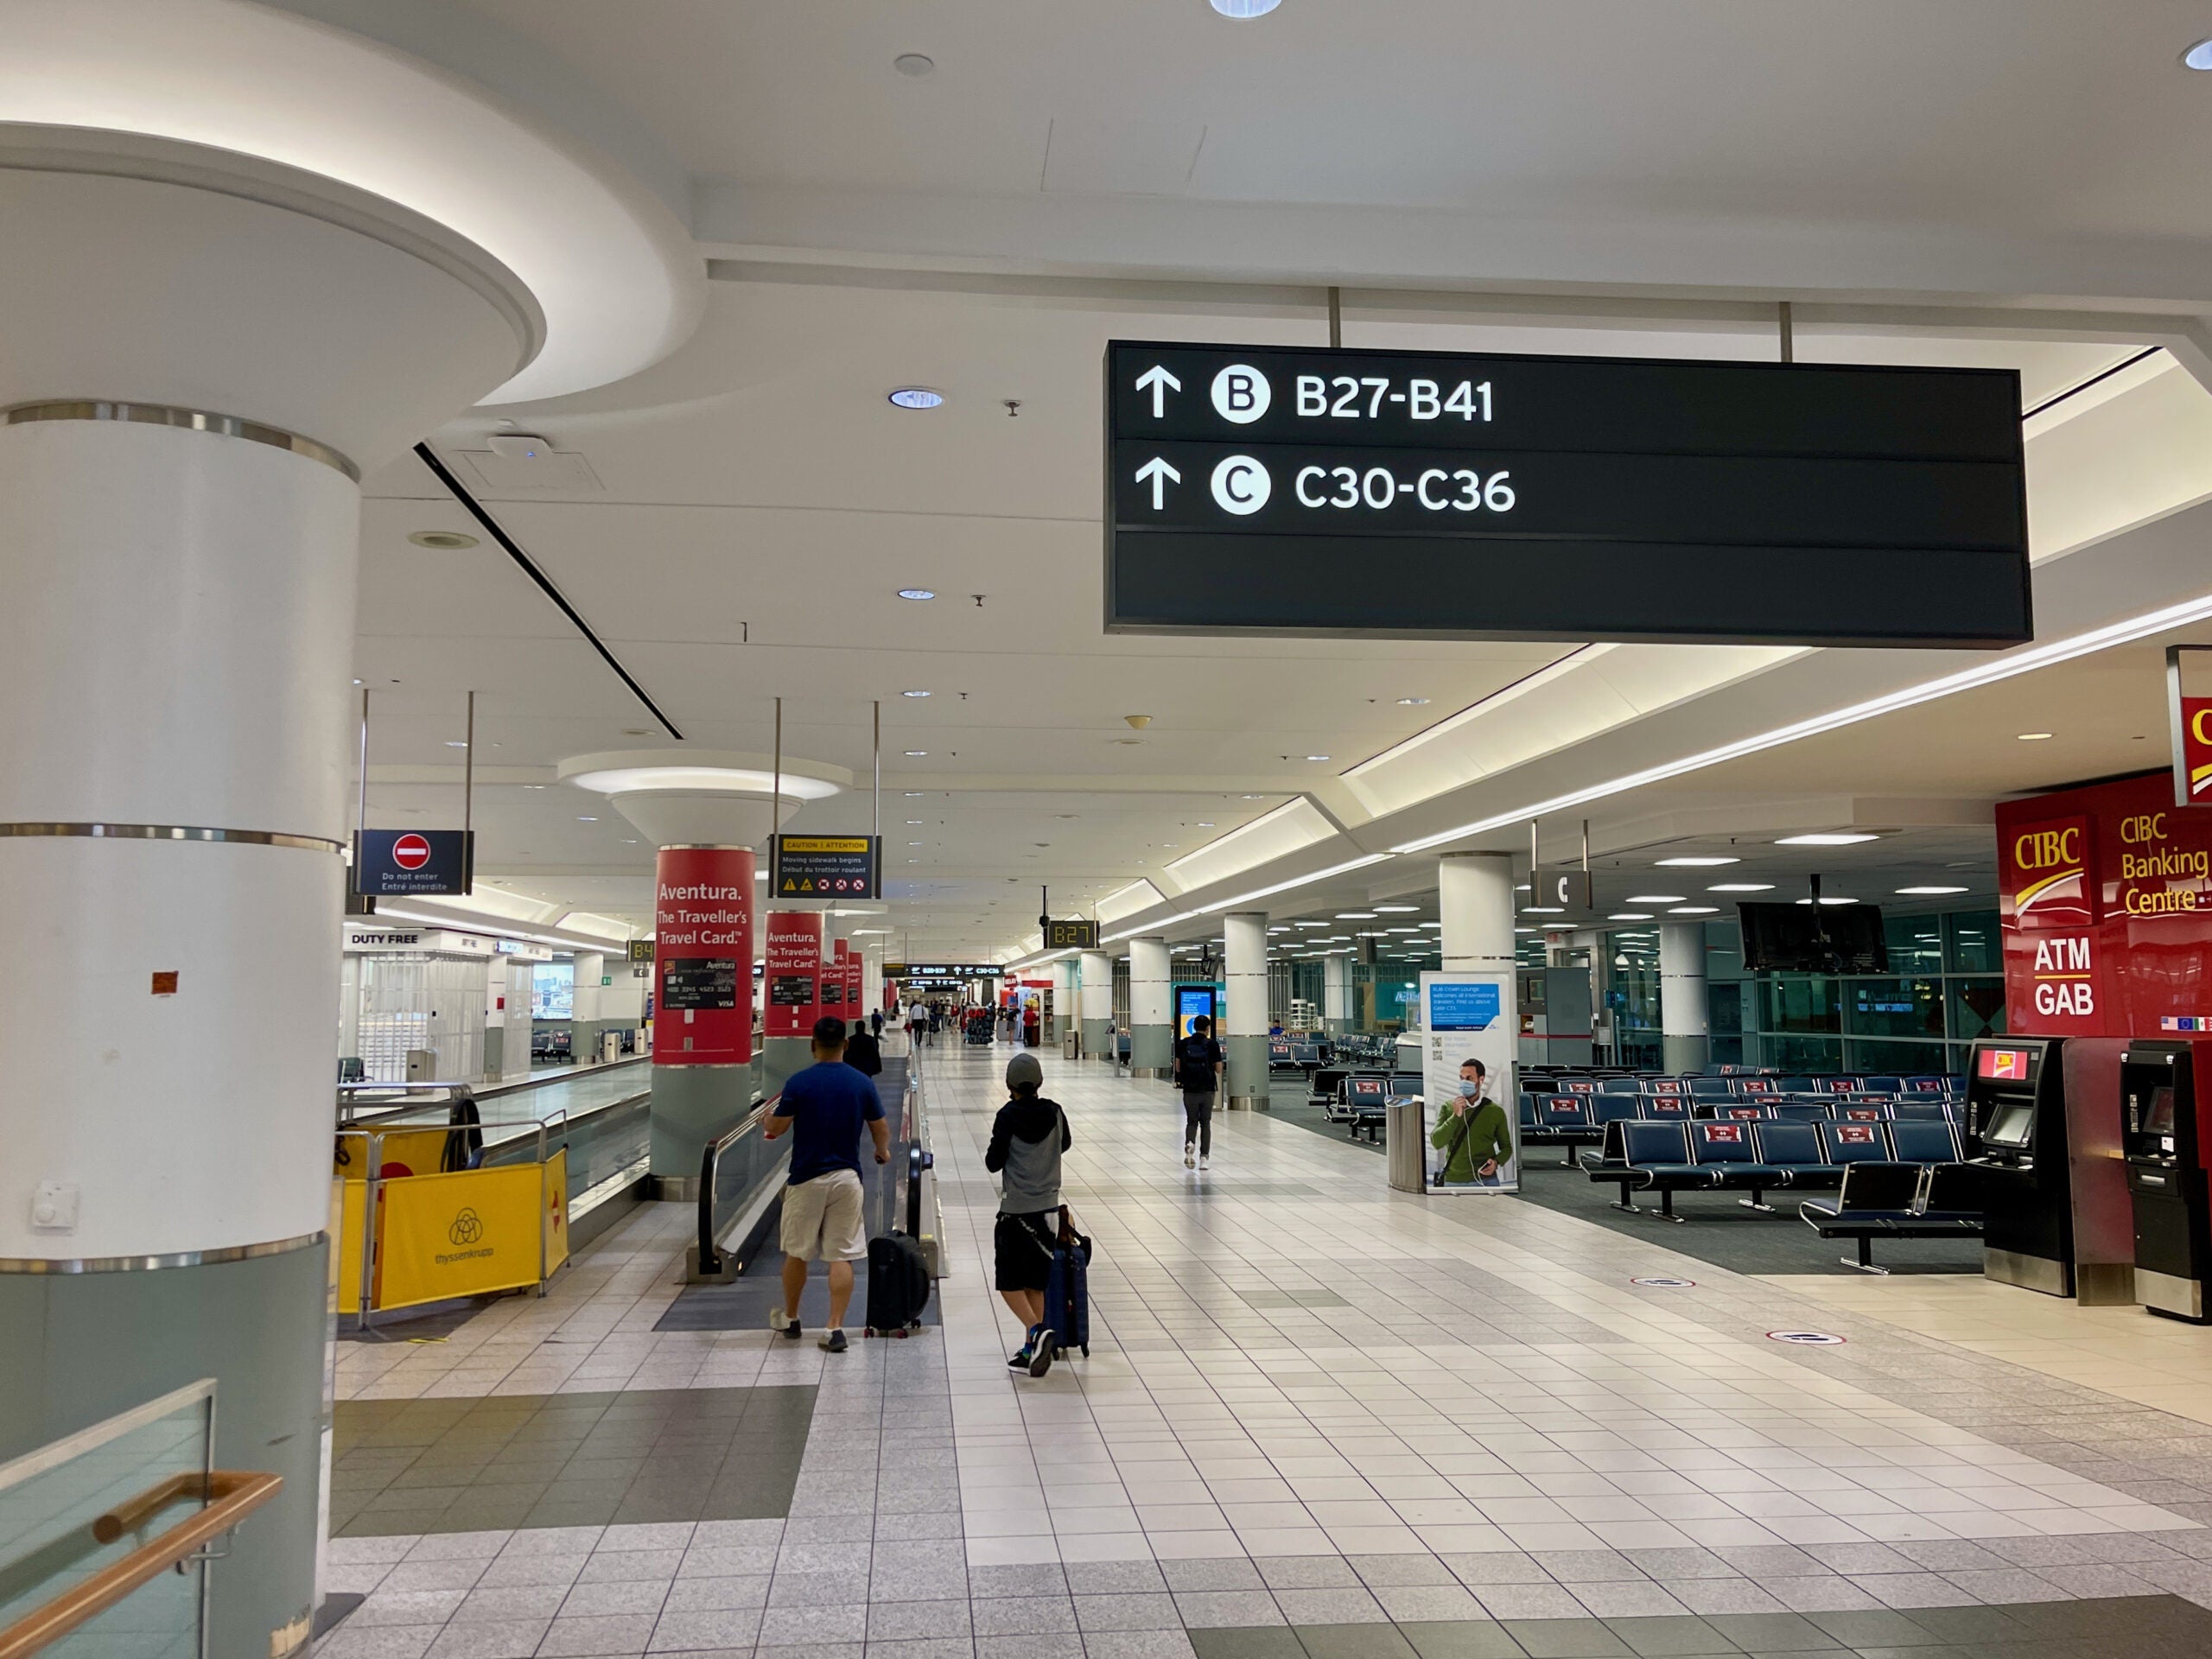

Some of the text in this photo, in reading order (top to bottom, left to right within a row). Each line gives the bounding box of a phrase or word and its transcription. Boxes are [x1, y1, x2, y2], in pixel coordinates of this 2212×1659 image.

[1228, 374, 1492, 422] B B27-B41
[1225, 465, 1516, 512] C C30-C36
[2120, 812, 2167, 843] CIBC
[2015, 827, 2080, 870] CIBC
[2122, 846, 2209, 880] Banking
[382, 872, 394, 880] Do
[409, 882, 448, 891] interdite
[659, 883, 741, 900] Aventura.
[2126, 886, 2196, 914] Centre
[658, 909, 747, 924] The Traveller's
[352, 935, 418, 944] DUTY FREE
[660, 930, 696, 944] Travel
[768, 932, 817, 943] Aventura.
[1055, 925, 1089, 943] B27
[634, 944, 653, 958] B4
[780, 947, 819, 956] Traveller's
[2034, 937, 2091, 971] ATM
[769, 959, 791, 968] Travel
[2035, 982, 2094, 1015] GAB
[435, 1248, 493, 1265] thyssenkrupp
